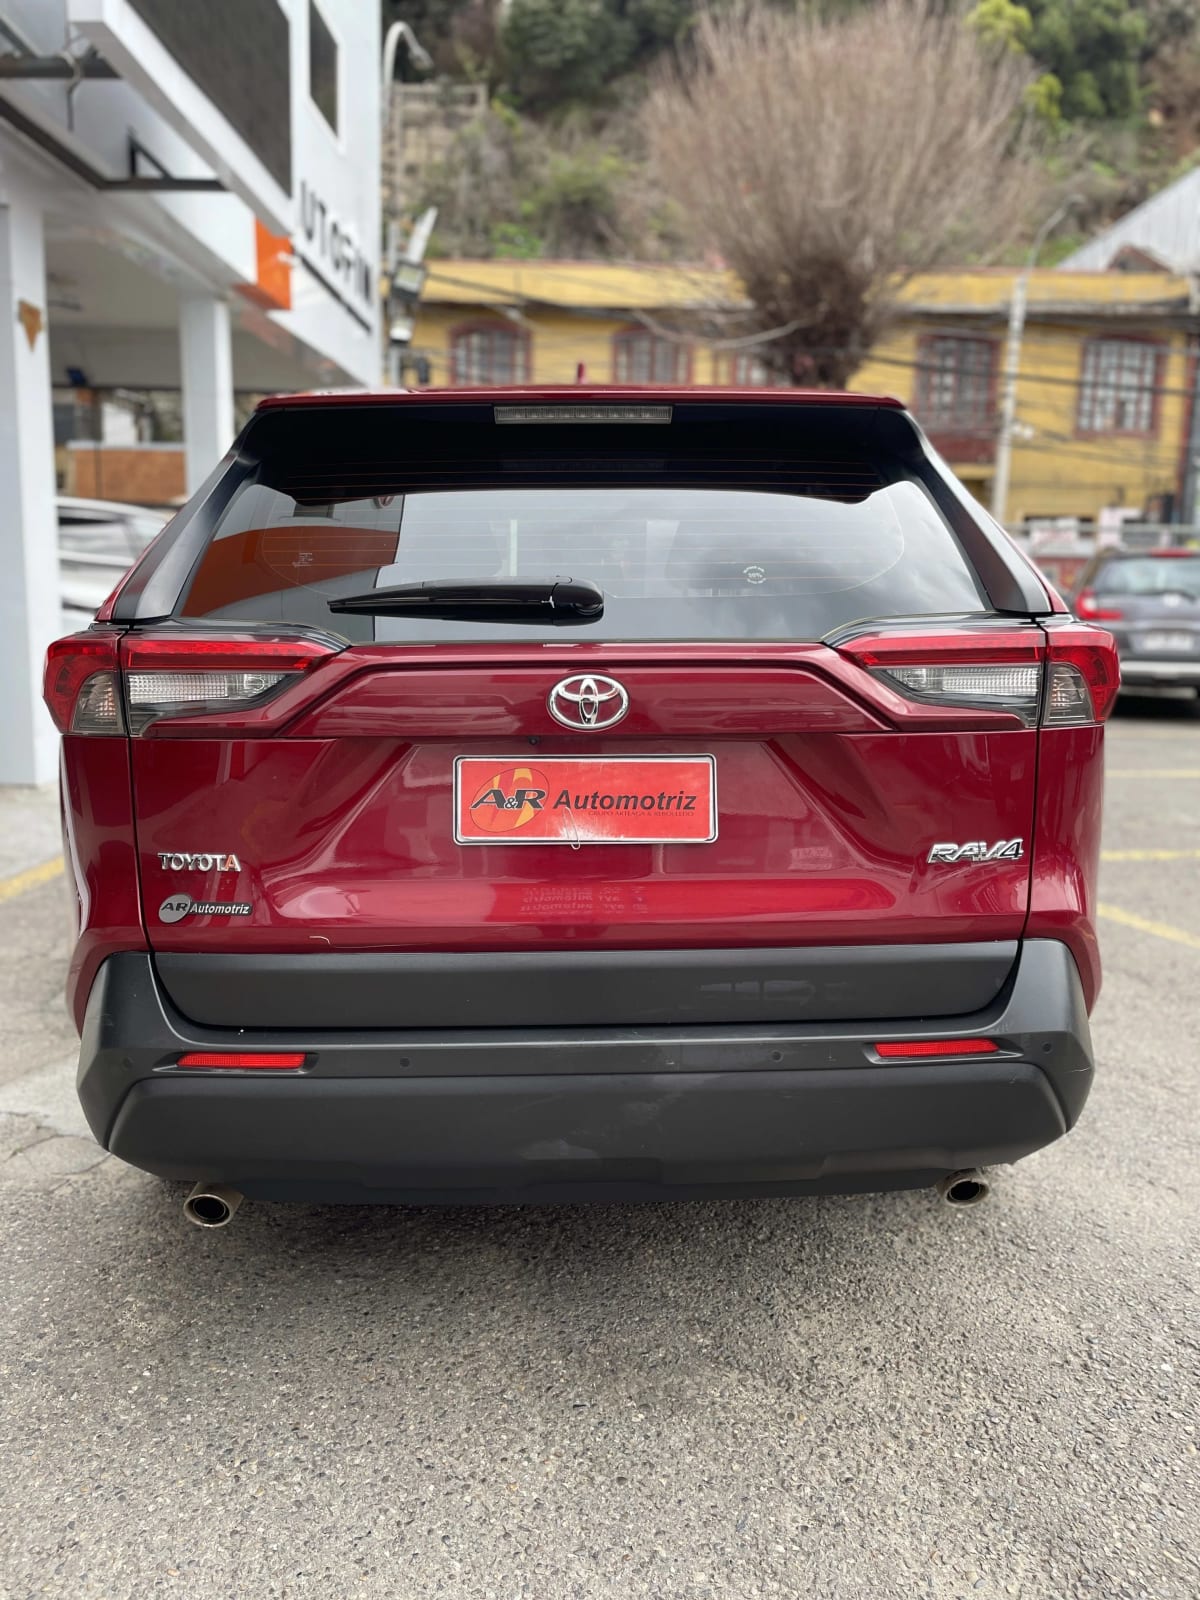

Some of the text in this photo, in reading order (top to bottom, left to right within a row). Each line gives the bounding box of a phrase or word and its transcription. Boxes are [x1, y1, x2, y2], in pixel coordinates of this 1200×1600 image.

[469, 788, 698, 810] A&R Automotriz
[927, 838, 1025, 864] RAV4
[157, 852, 242, 872] TOYOTA
[161, 902, 250, 914] AR Automotriz
